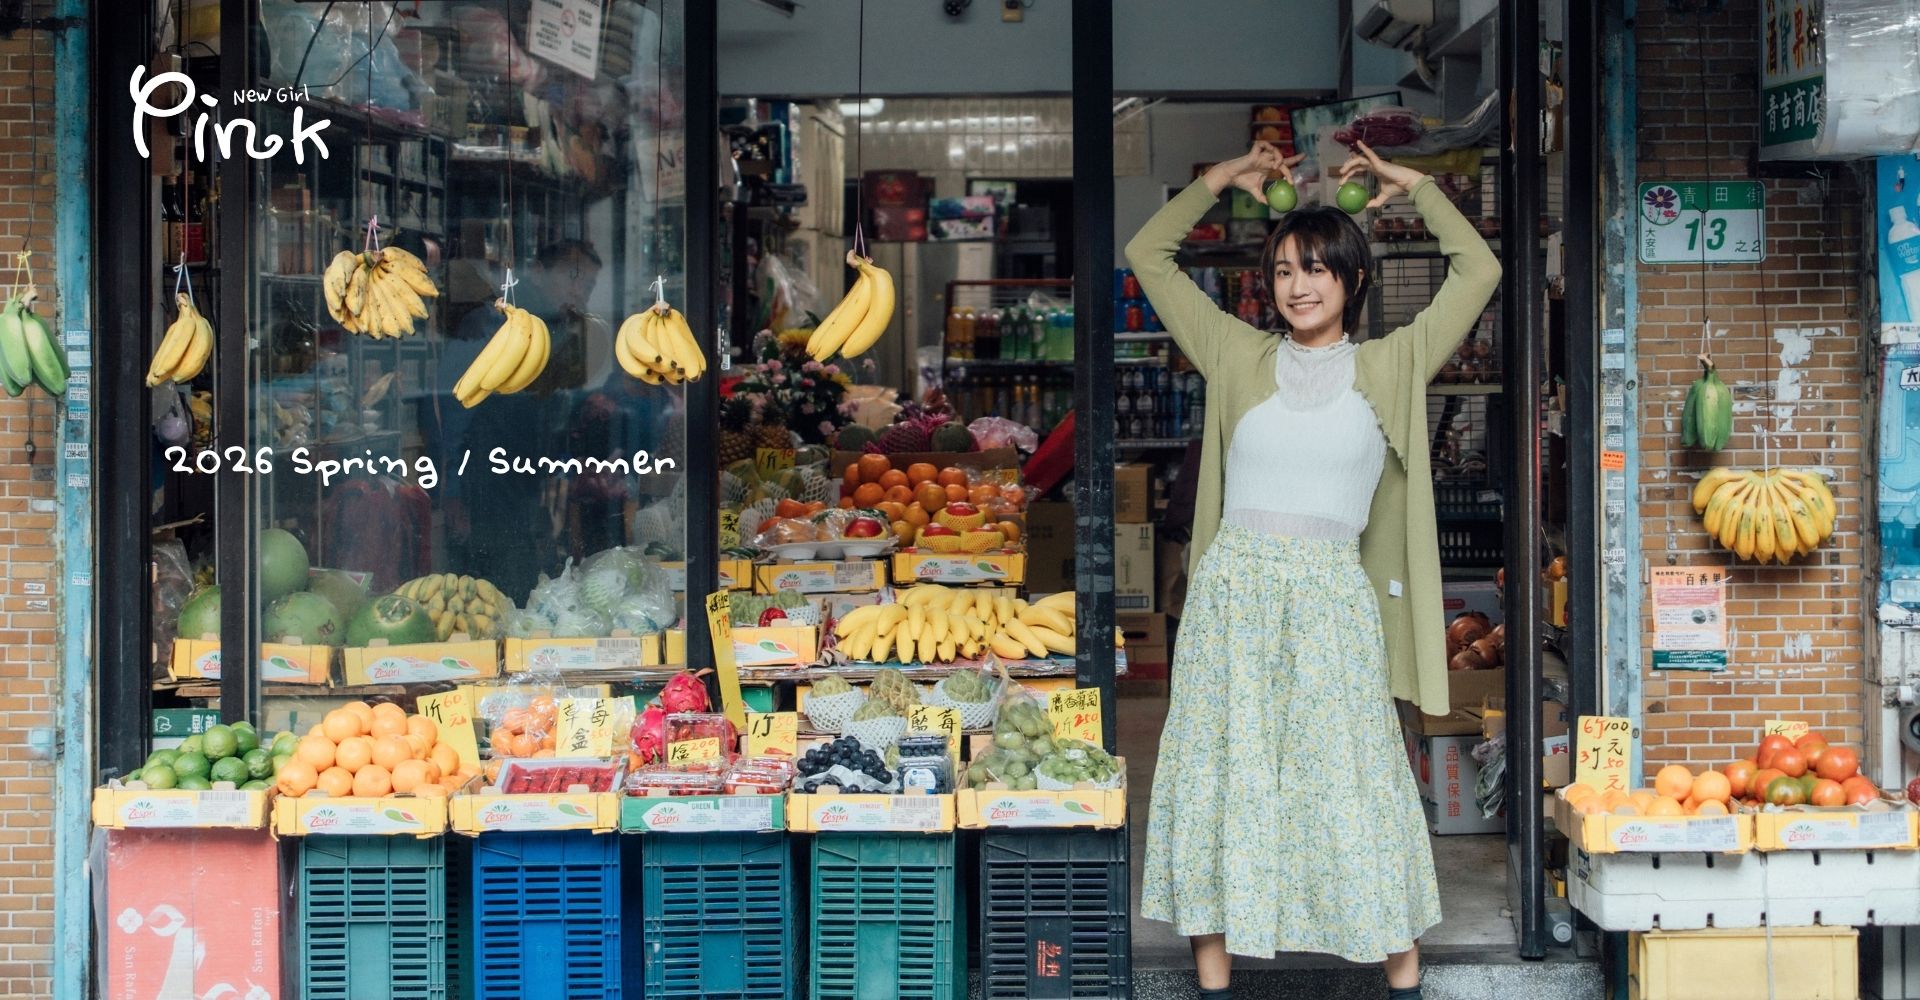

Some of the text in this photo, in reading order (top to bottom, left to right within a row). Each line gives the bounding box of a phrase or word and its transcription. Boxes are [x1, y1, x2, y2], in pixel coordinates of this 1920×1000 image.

[1683, 186, 1761, 204] 青田街
[1645, 227, 1656, 258] 大安區
[1685, 217, 1727, 251] 13
[1447, 746, 1461, 817] 品質保證
[652, 813, 680, 826] Zespri
[820, 811, 849, 824] Zespri
[990, 807, 1019, 820] Zespri
[253, 906, 263, 946] Rafael
